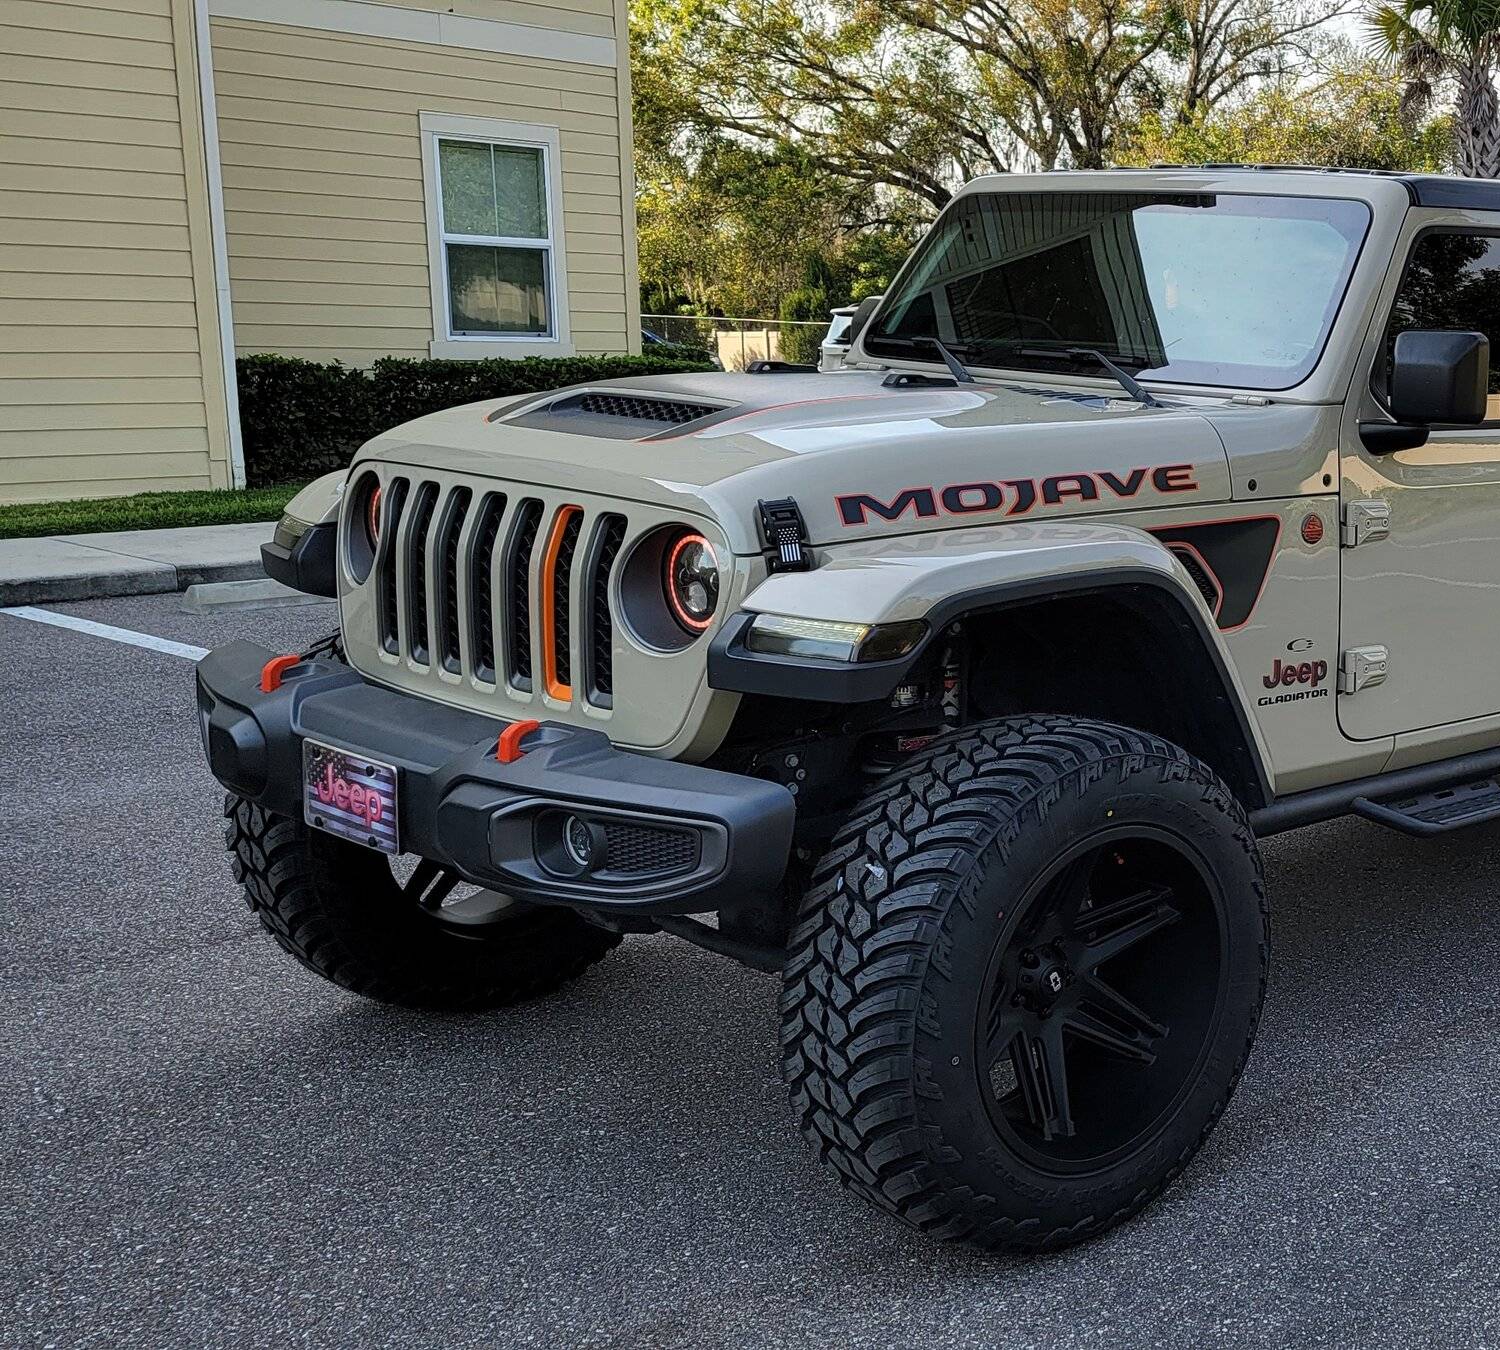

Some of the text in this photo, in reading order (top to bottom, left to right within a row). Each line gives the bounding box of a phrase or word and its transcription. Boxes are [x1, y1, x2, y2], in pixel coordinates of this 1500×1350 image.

[834, 463, 1199, 528] MOJAVE
[1257, 688, 1329, 707] GLADIATOR
[1262, 659, 1328, 689] Jeep
[317, 762, 383, 832] Jeep
